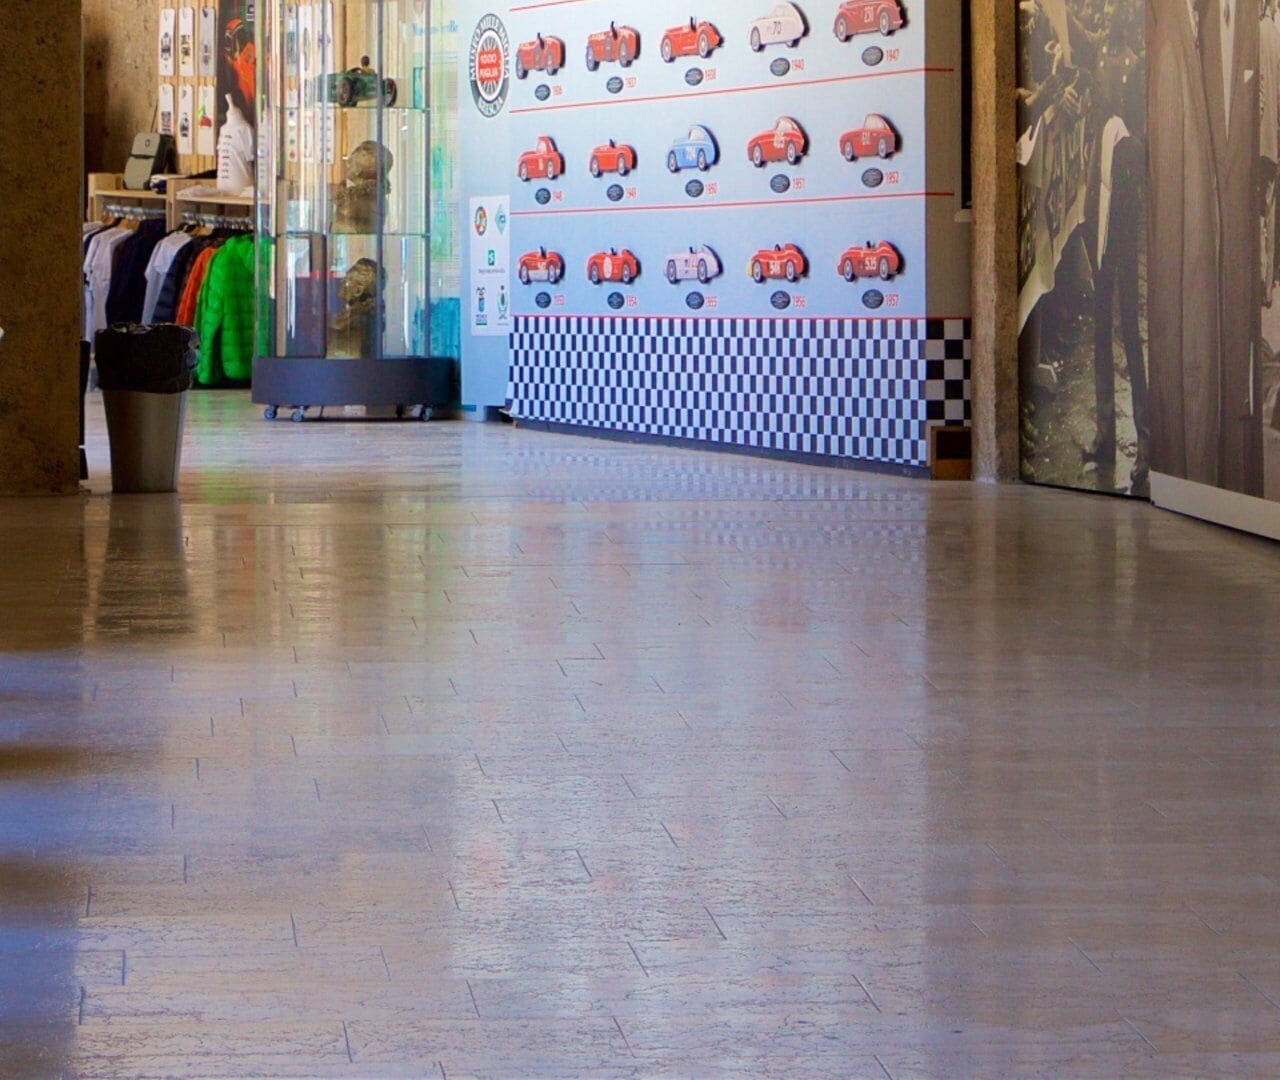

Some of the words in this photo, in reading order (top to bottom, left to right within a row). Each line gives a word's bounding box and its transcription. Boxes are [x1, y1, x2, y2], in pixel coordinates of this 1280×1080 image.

[771, 20, 782, 36] 70
[885, 48, 900, 62] 1947
[885, 170, 900, 185] 1952
[885, 293, 900, 307] 1957
